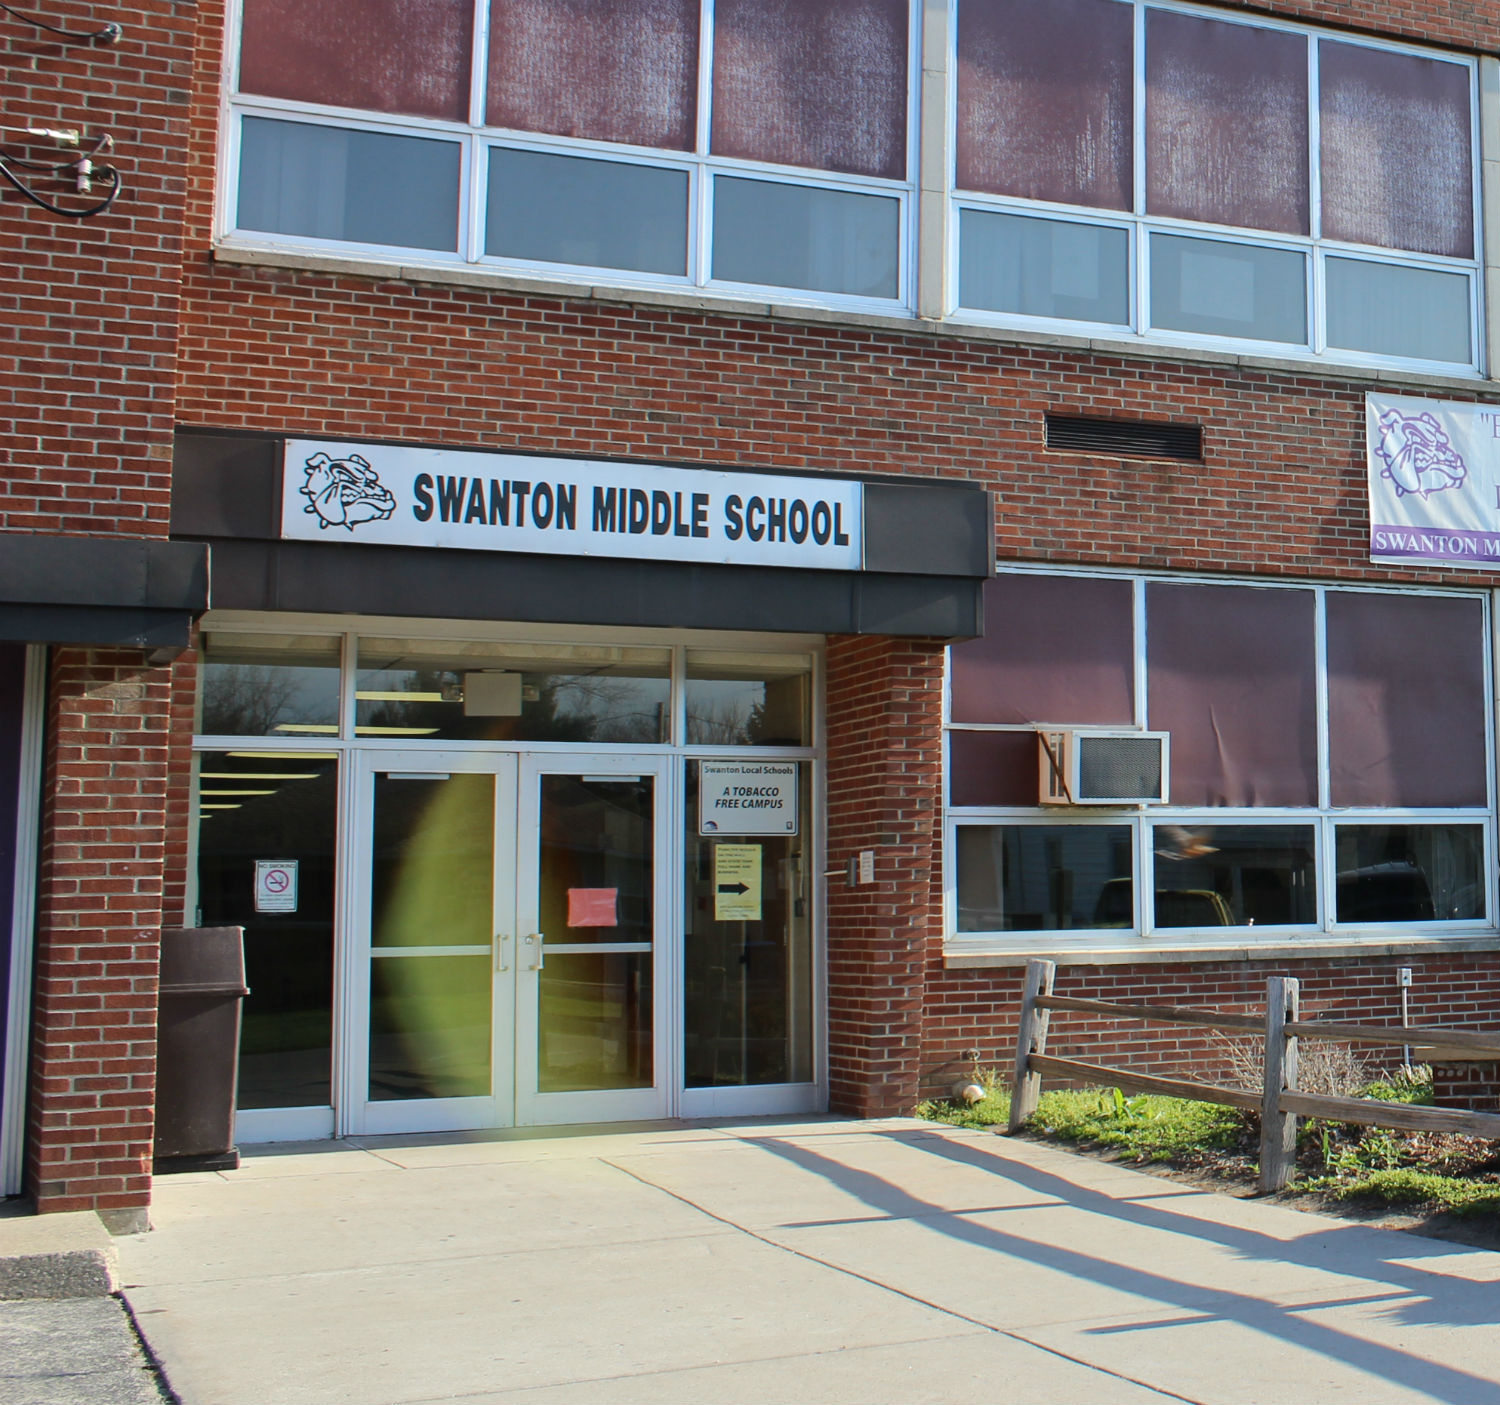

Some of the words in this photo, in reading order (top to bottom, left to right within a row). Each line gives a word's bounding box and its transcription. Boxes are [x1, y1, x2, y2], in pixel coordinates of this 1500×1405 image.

[412, 472, 577, 531] SWANTON
[591, 486, 710, 538] MIDDLE
[723, 494, 850, 546] SCHOOL
[1375, 531, 1478, 556] SWANTON
[704, 765, 740, 774] Swanton
[741, 766, 762, 775] Local
[763, 766, 794, 776] Schools
[723, 787, 731, 797] A
[732, 787, 779, 797] TOBACCO
[715, 799, 740, 809] FREE
[741, 799, 783, 809] CAMPUS
